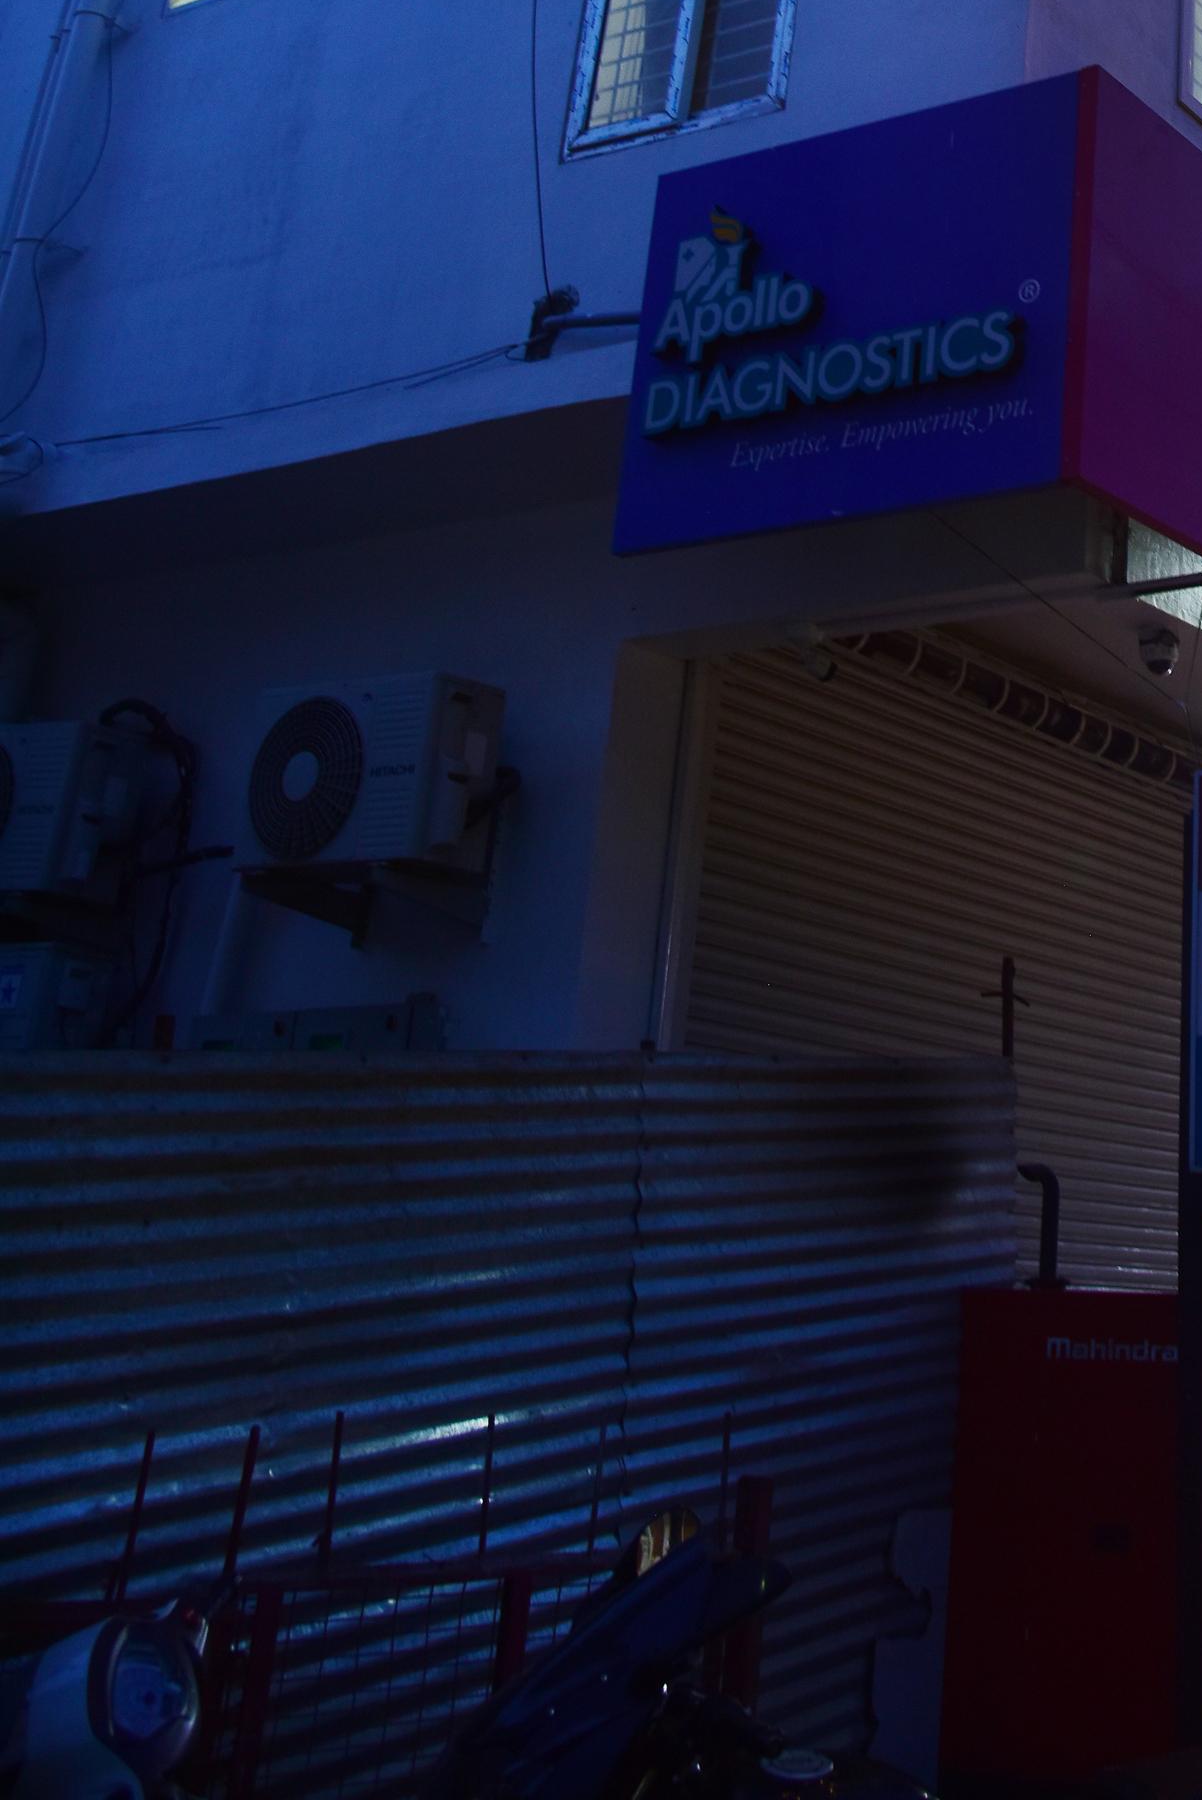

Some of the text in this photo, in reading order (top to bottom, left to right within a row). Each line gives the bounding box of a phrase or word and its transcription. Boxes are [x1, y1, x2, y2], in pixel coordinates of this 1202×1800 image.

[655, 276, 812, 363] Apollo
[645, 311, 1013, 431] DIAGNOSTICS
[841, 405, 980, 452] Empowering
